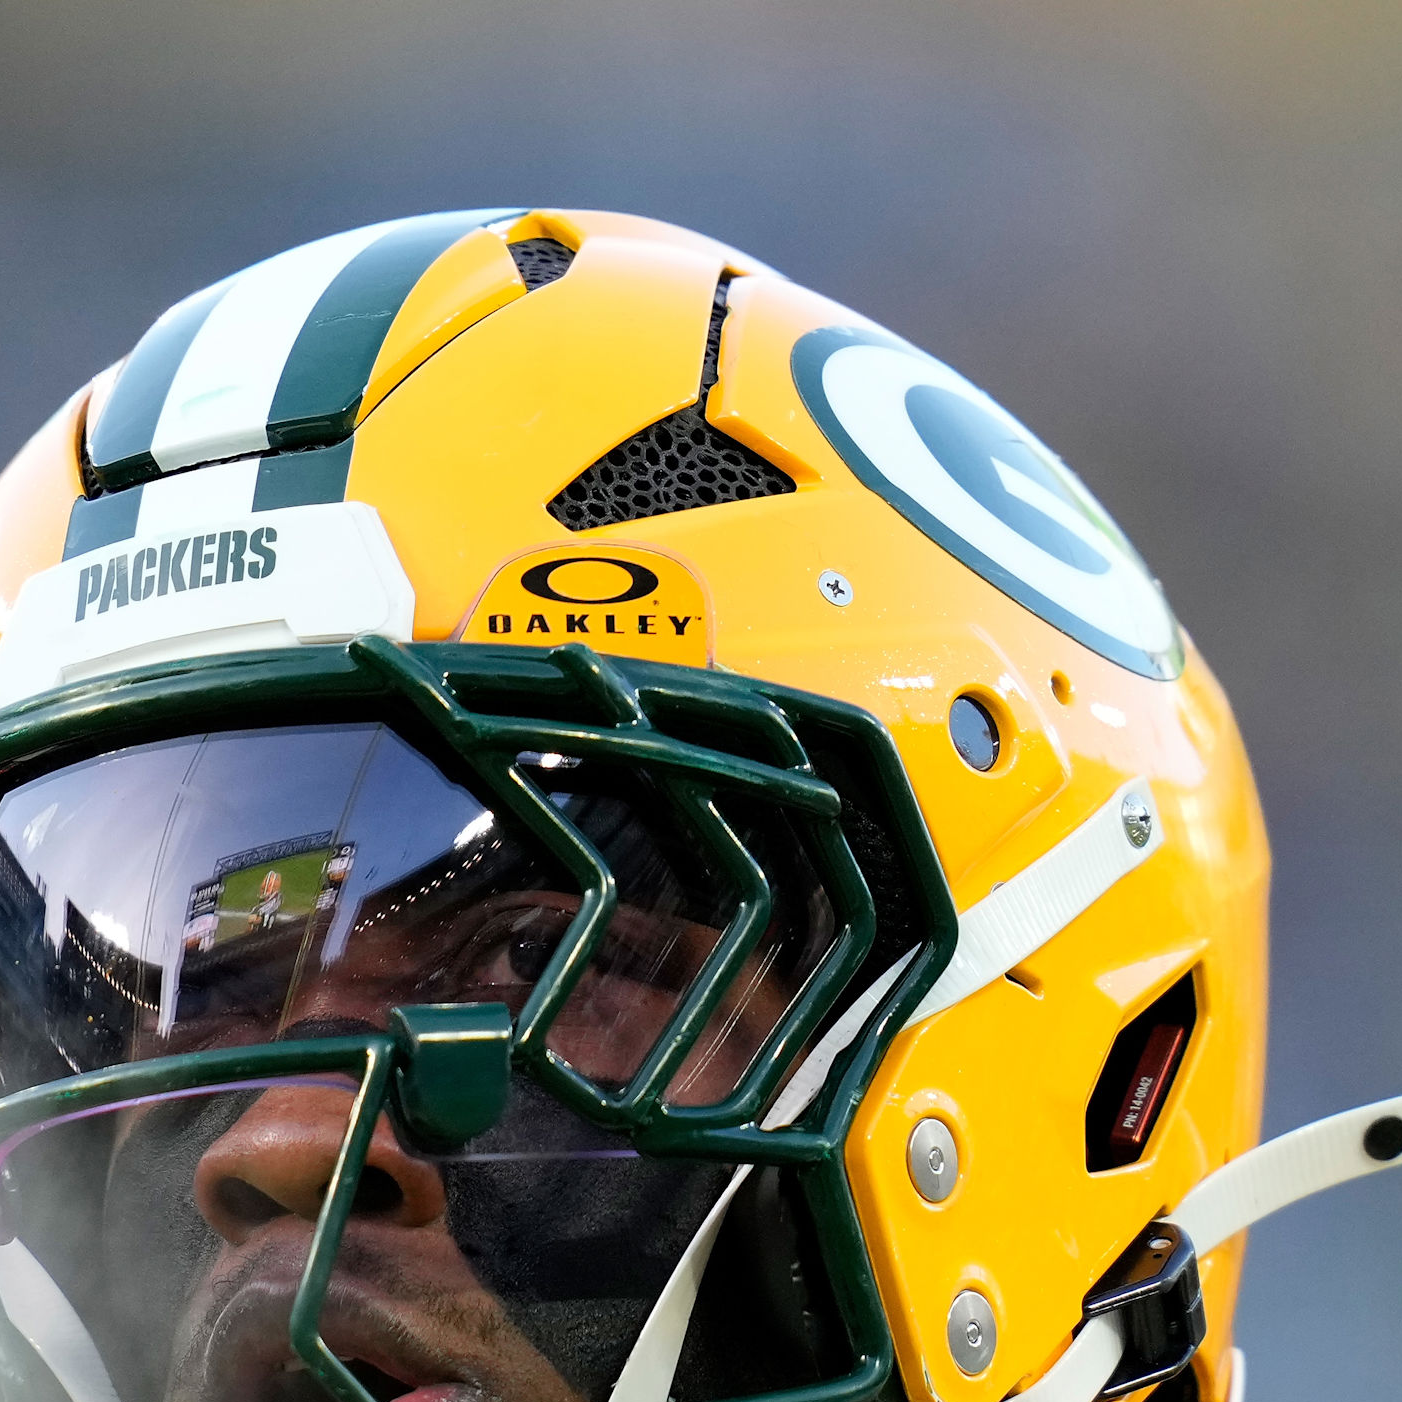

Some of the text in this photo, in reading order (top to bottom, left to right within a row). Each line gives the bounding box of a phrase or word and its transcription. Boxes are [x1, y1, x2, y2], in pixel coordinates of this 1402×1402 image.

[74, 526, 278, 623] PACKERS
[488, 613, 692, 636] OAKLEY
[1122, 1111, 1139, 1128] PN:
